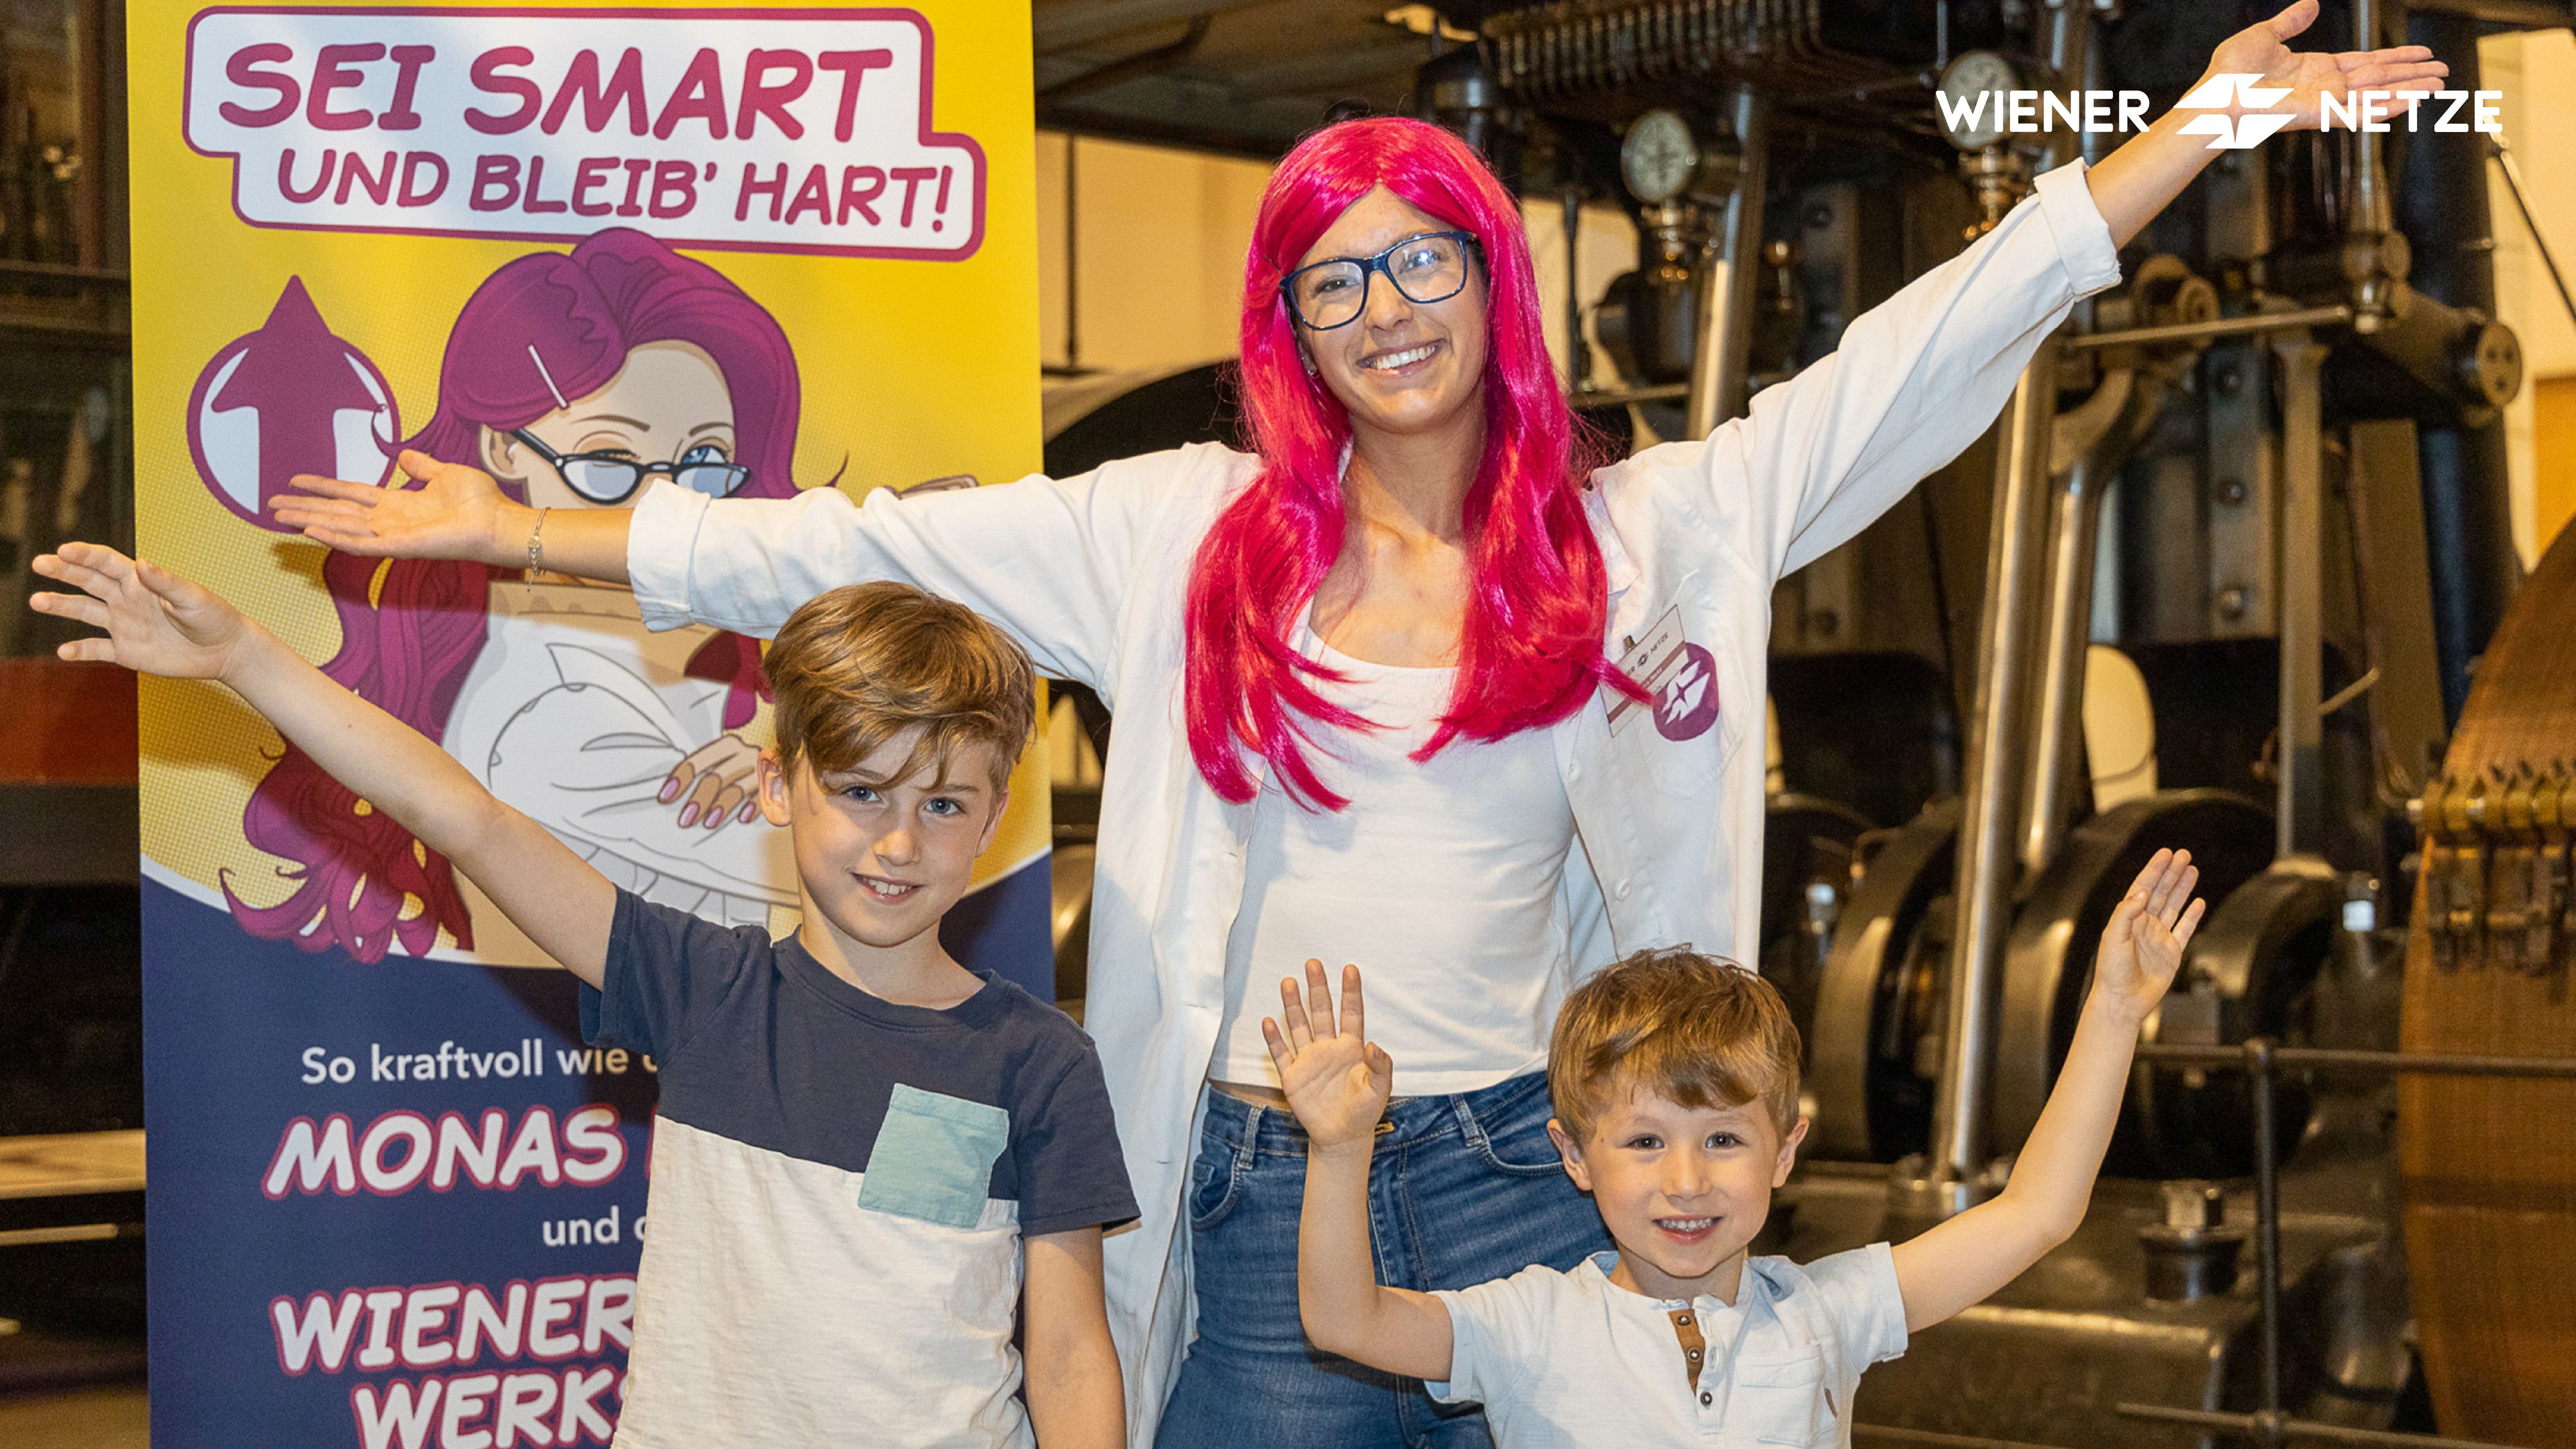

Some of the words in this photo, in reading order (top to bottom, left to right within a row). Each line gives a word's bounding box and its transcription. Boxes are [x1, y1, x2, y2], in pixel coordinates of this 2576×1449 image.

[218, 41, 436, 132] SEI
[464, 44, 893, 142] SMART
[277, 147, 450, 209] UND
[735, 162, 954, 233] HART!
[301, 1046, 355, 1085] So
[371, 1038, 543, 1083] kraftvoll
[556, 1046, 629, 1076] wie
[262, 1104, 628, 1199] MONAS
[543, 1205, 620, 1246] und
[270, 1274, 638, 1374] WIENER
[351, 1365, 629, 1448] WERK
